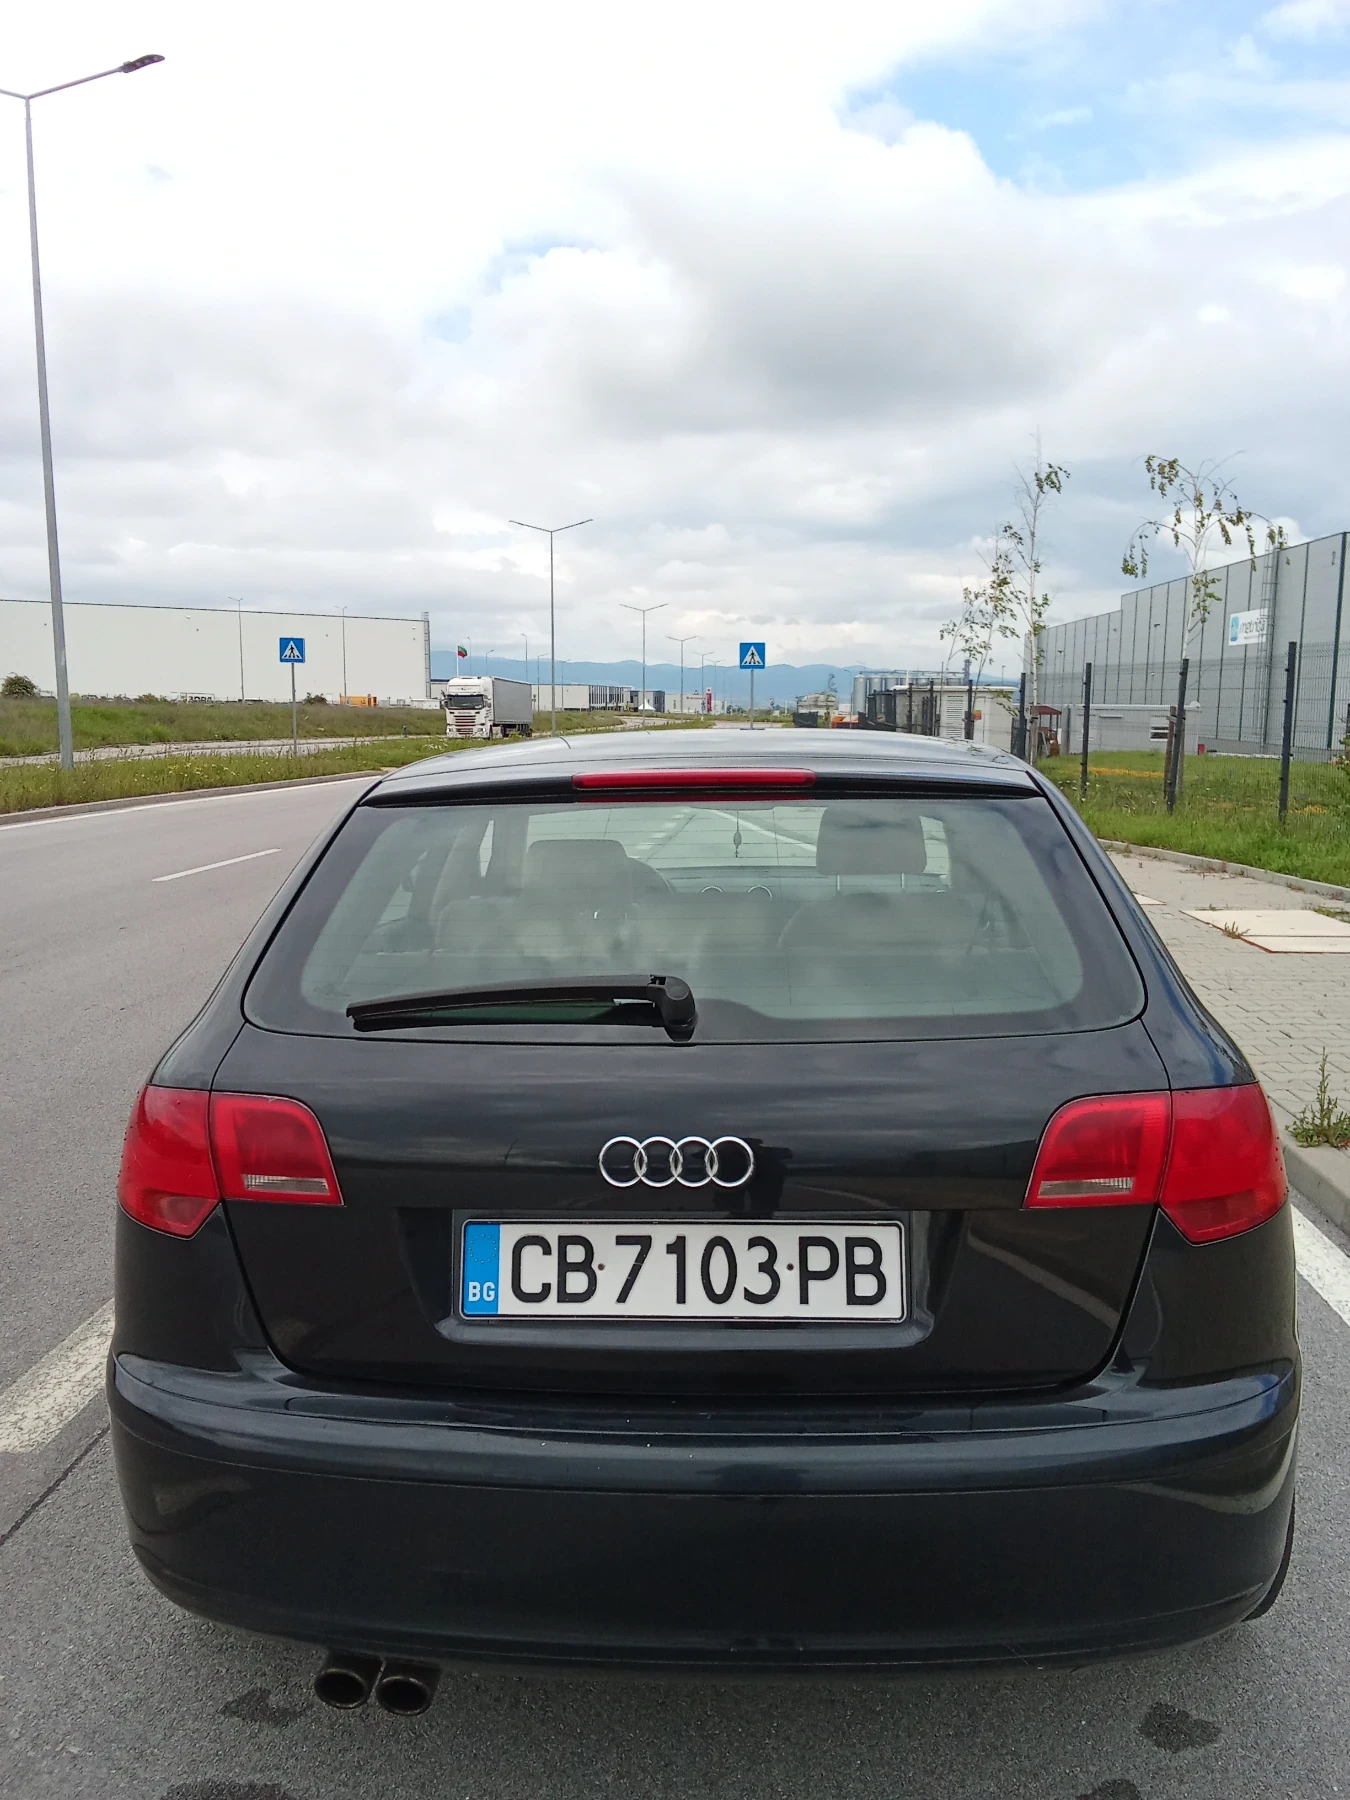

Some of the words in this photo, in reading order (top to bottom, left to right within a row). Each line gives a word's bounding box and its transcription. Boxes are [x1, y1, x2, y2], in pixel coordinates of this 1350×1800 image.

[468, 1281, 496, 1302] BG
[511, 1234, 598, 1304] CB
[614, 1234, 781, 1305] 7103
[799, 1235, 888, 1306] PB
